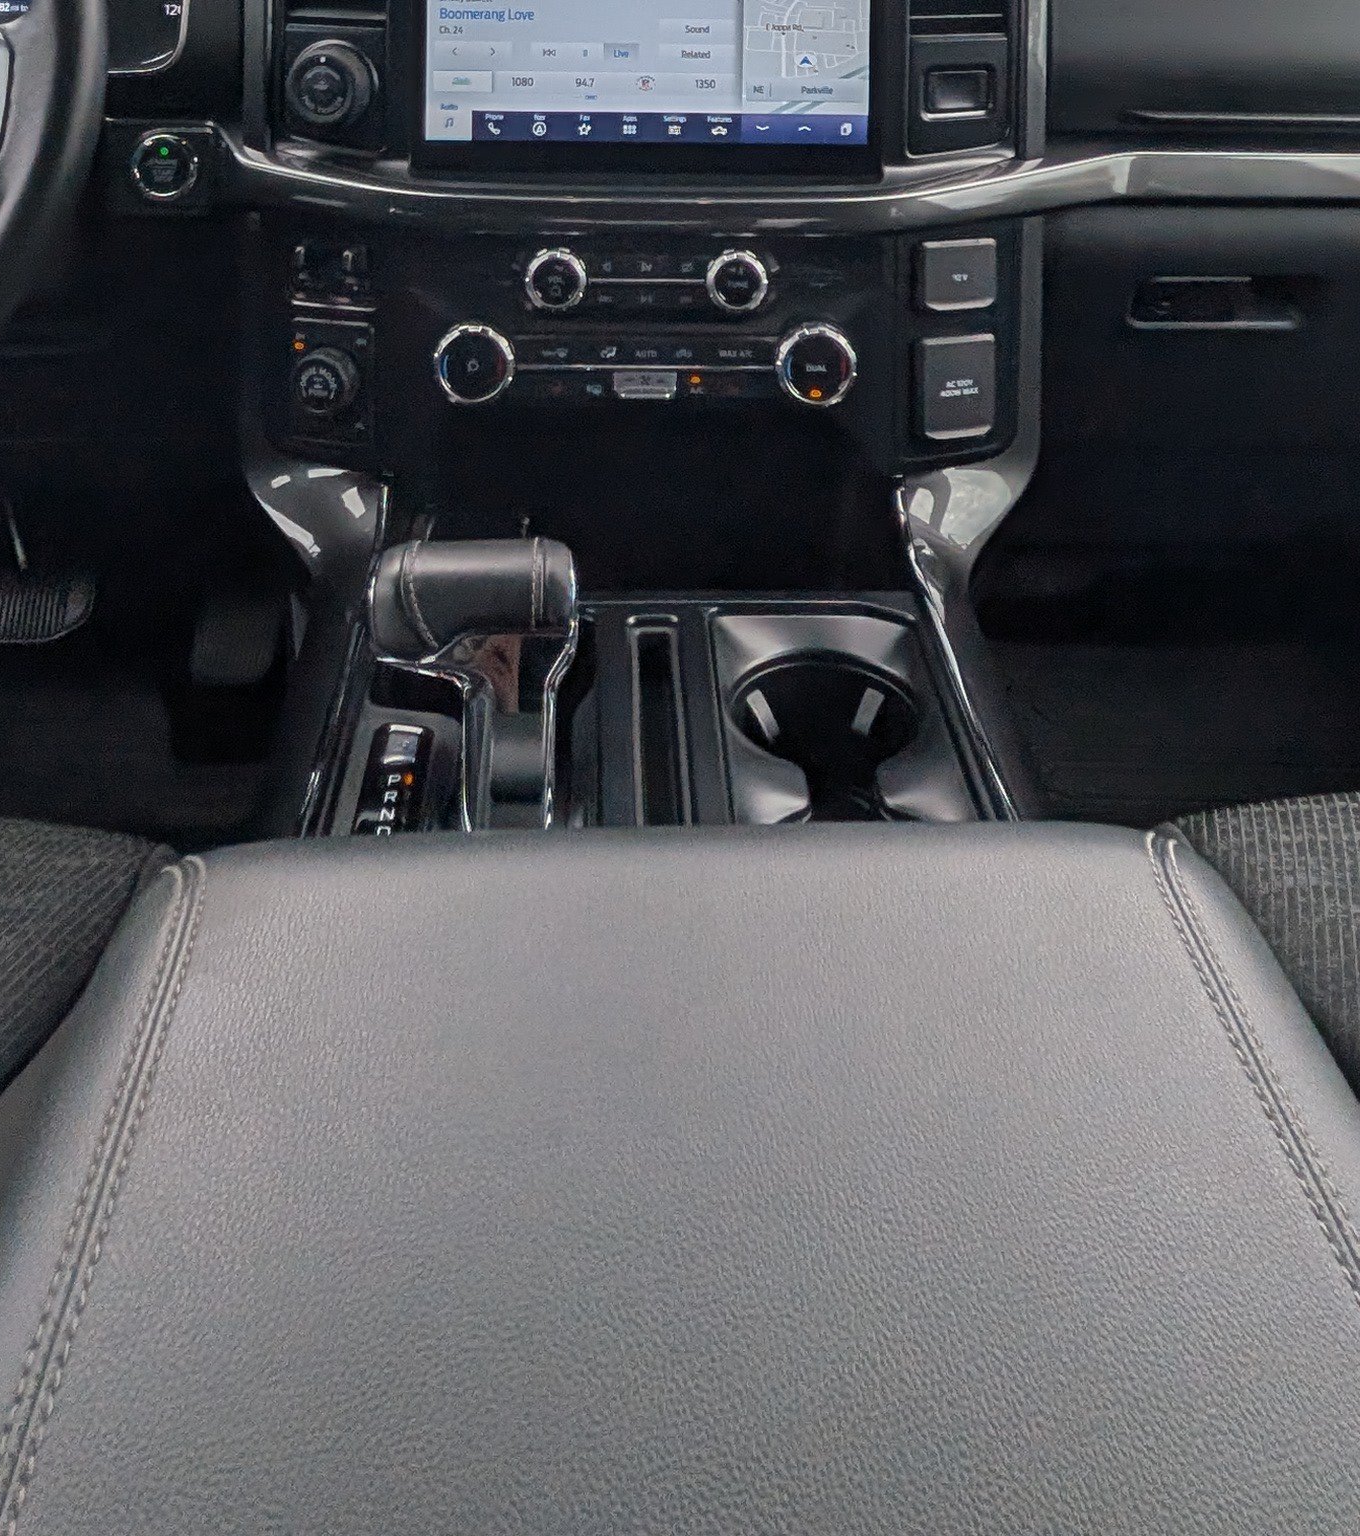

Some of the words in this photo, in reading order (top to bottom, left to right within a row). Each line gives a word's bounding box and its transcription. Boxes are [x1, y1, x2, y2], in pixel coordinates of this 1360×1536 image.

[439, 8, 506, 22] Boomerang
[507, 8, 535, 21] Love
[453, 25, 464, 35] 24
[685, 25, 710, 35] Sound
[613, 49, 629, 59] Live
[681, 50, 711, 60] Related
[511, 77, 535, 87] 1080
[575, 77, 596, 89] 94.7
[695, 78, 717, 90] 1350
[801, 85, 834, 96] Parkville
[387, 774, 402, 787] P
[383, 790, 398, 804] R
[379, 806, 396, 822] N
